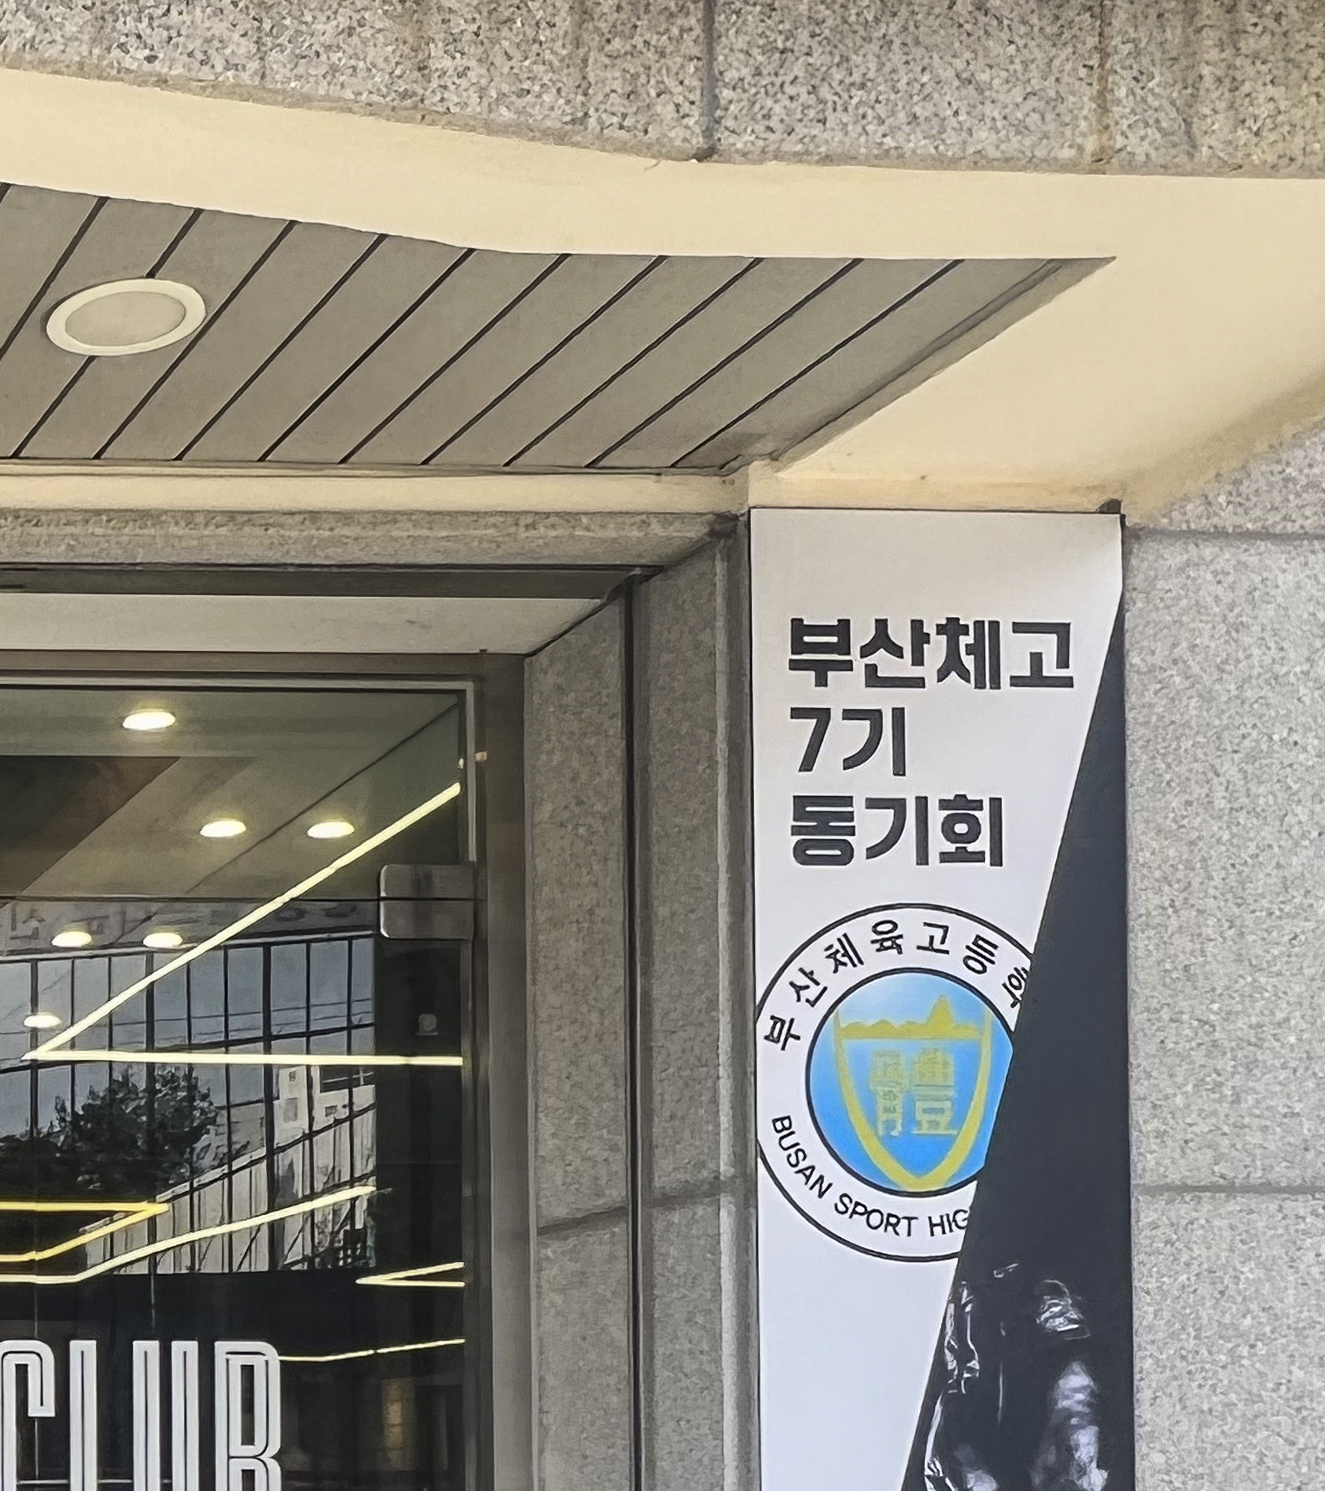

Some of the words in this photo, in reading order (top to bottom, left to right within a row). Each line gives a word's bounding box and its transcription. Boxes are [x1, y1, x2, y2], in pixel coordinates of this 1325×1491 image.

[788, 616, 1075, 690] 부산체고
[789, 706, 907, 777] 7기
[790, 794, 1004, 868] 동기회
[771, 1114, 834, 1199] BUSAN
[833, 1191, 919, 1237] SPORT
